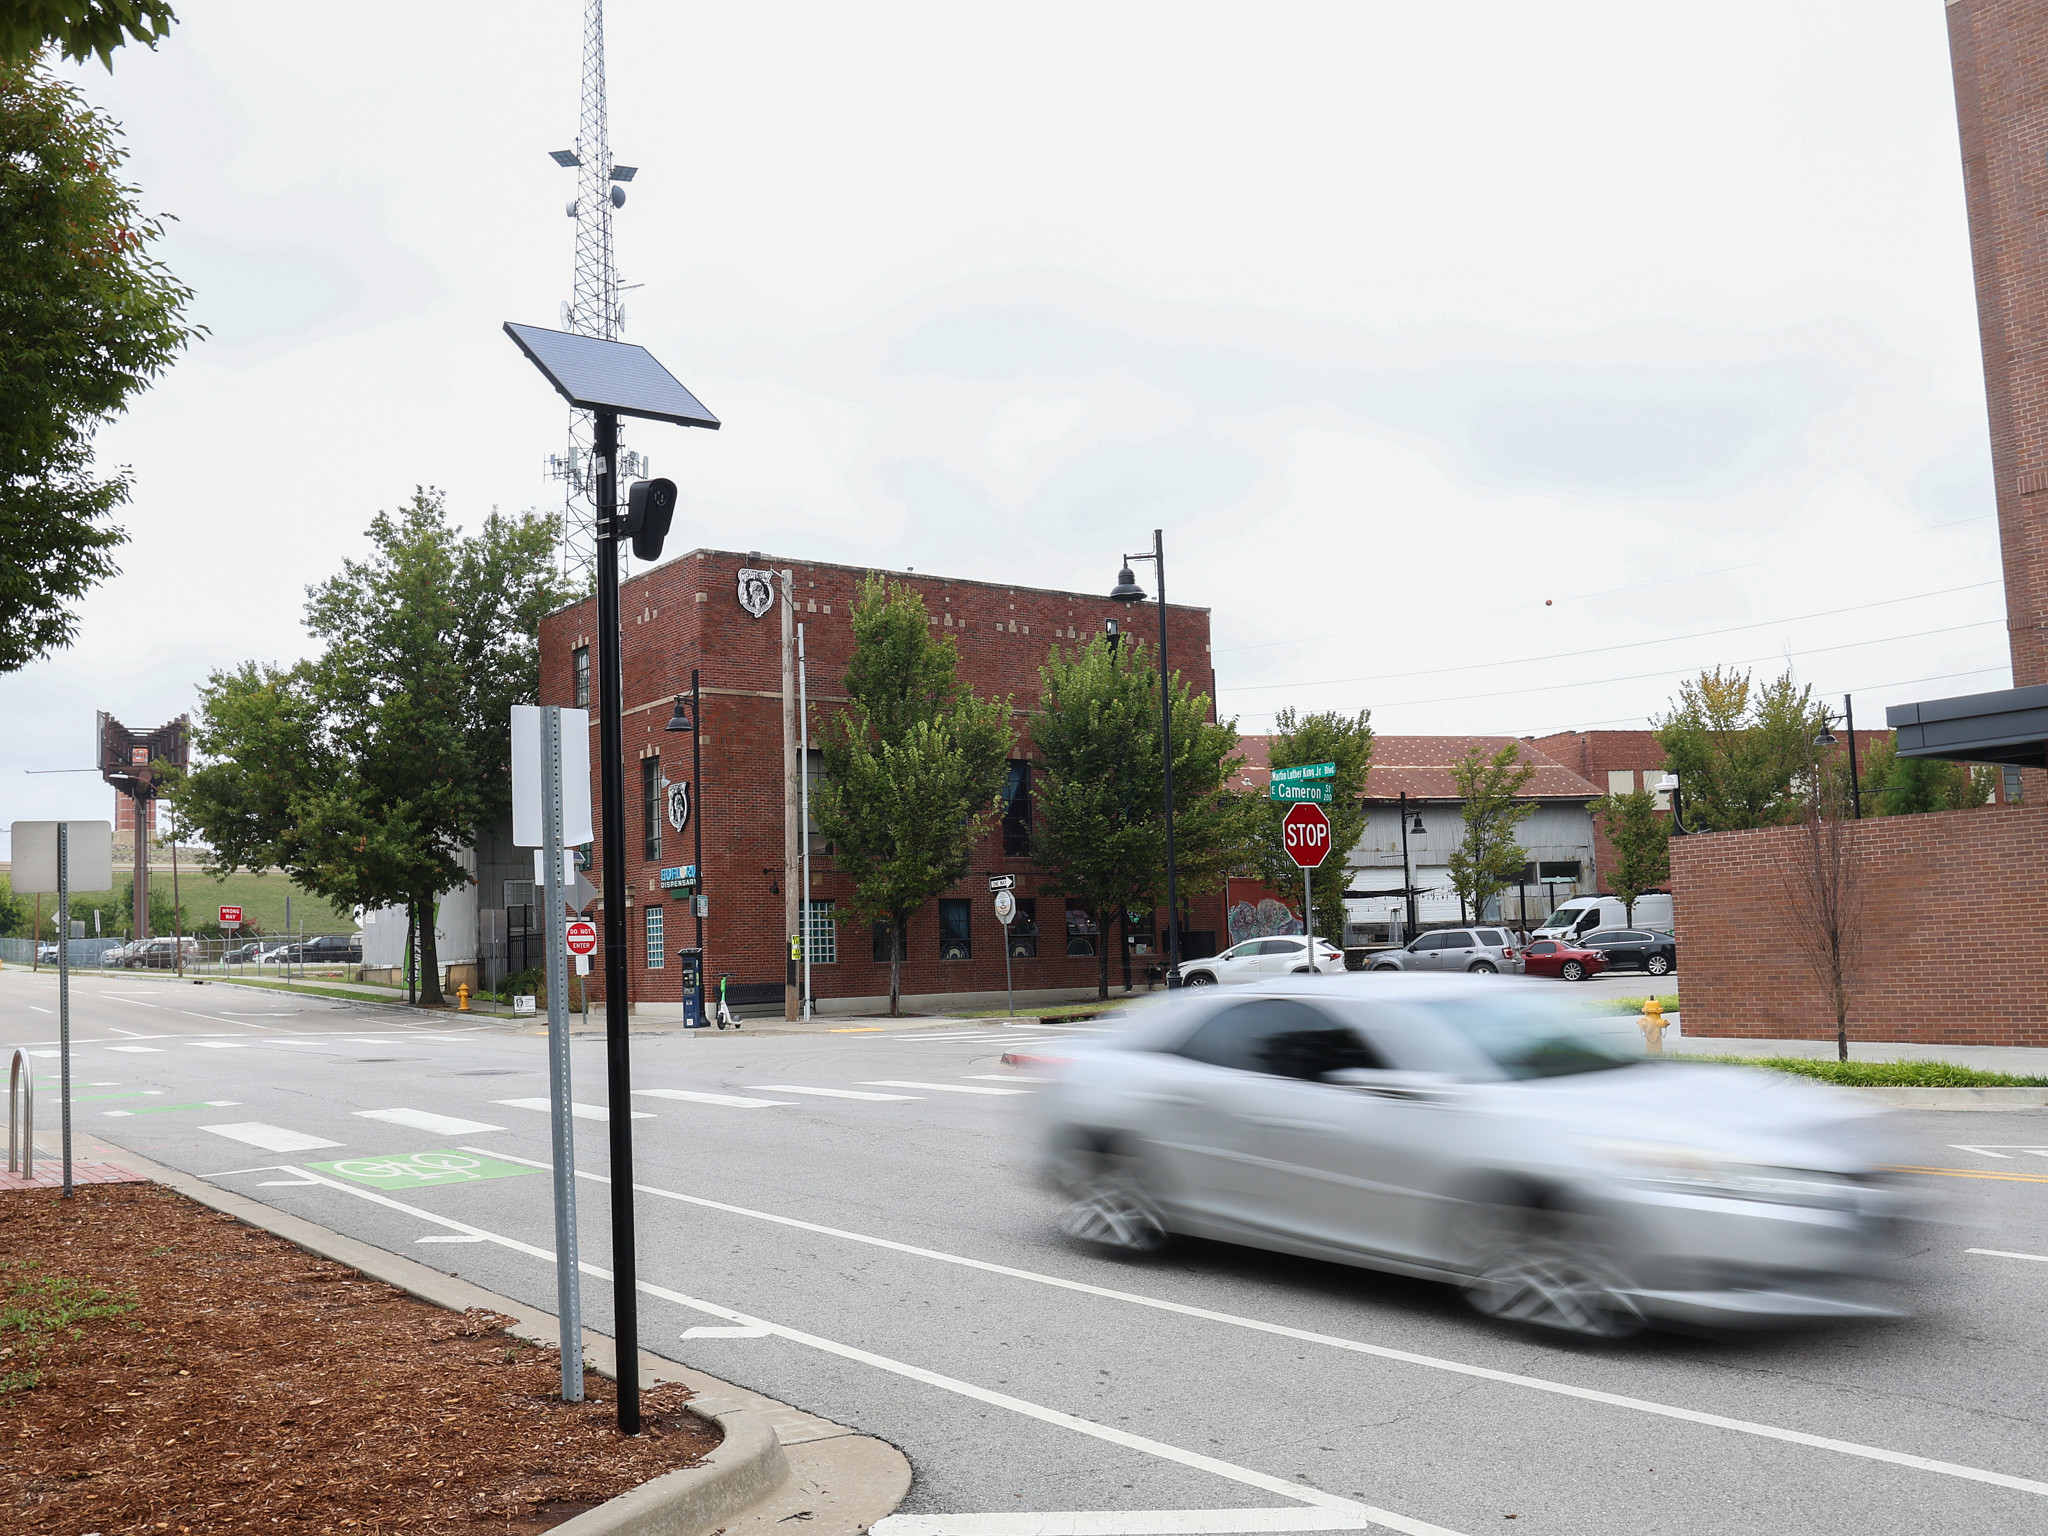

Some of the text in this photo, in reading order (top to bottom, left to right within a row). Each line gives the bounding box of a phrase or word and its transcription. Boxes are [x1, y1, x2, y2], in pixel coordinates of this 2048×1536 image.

[1271, 766, 1334, 781] Martin Luther King Jr Blvd
[1271, 783, 1331, 799] E Cameron St
[1287, 823, 1327, 847] STOP
[661, 866, 703, 880] EUFLORI
